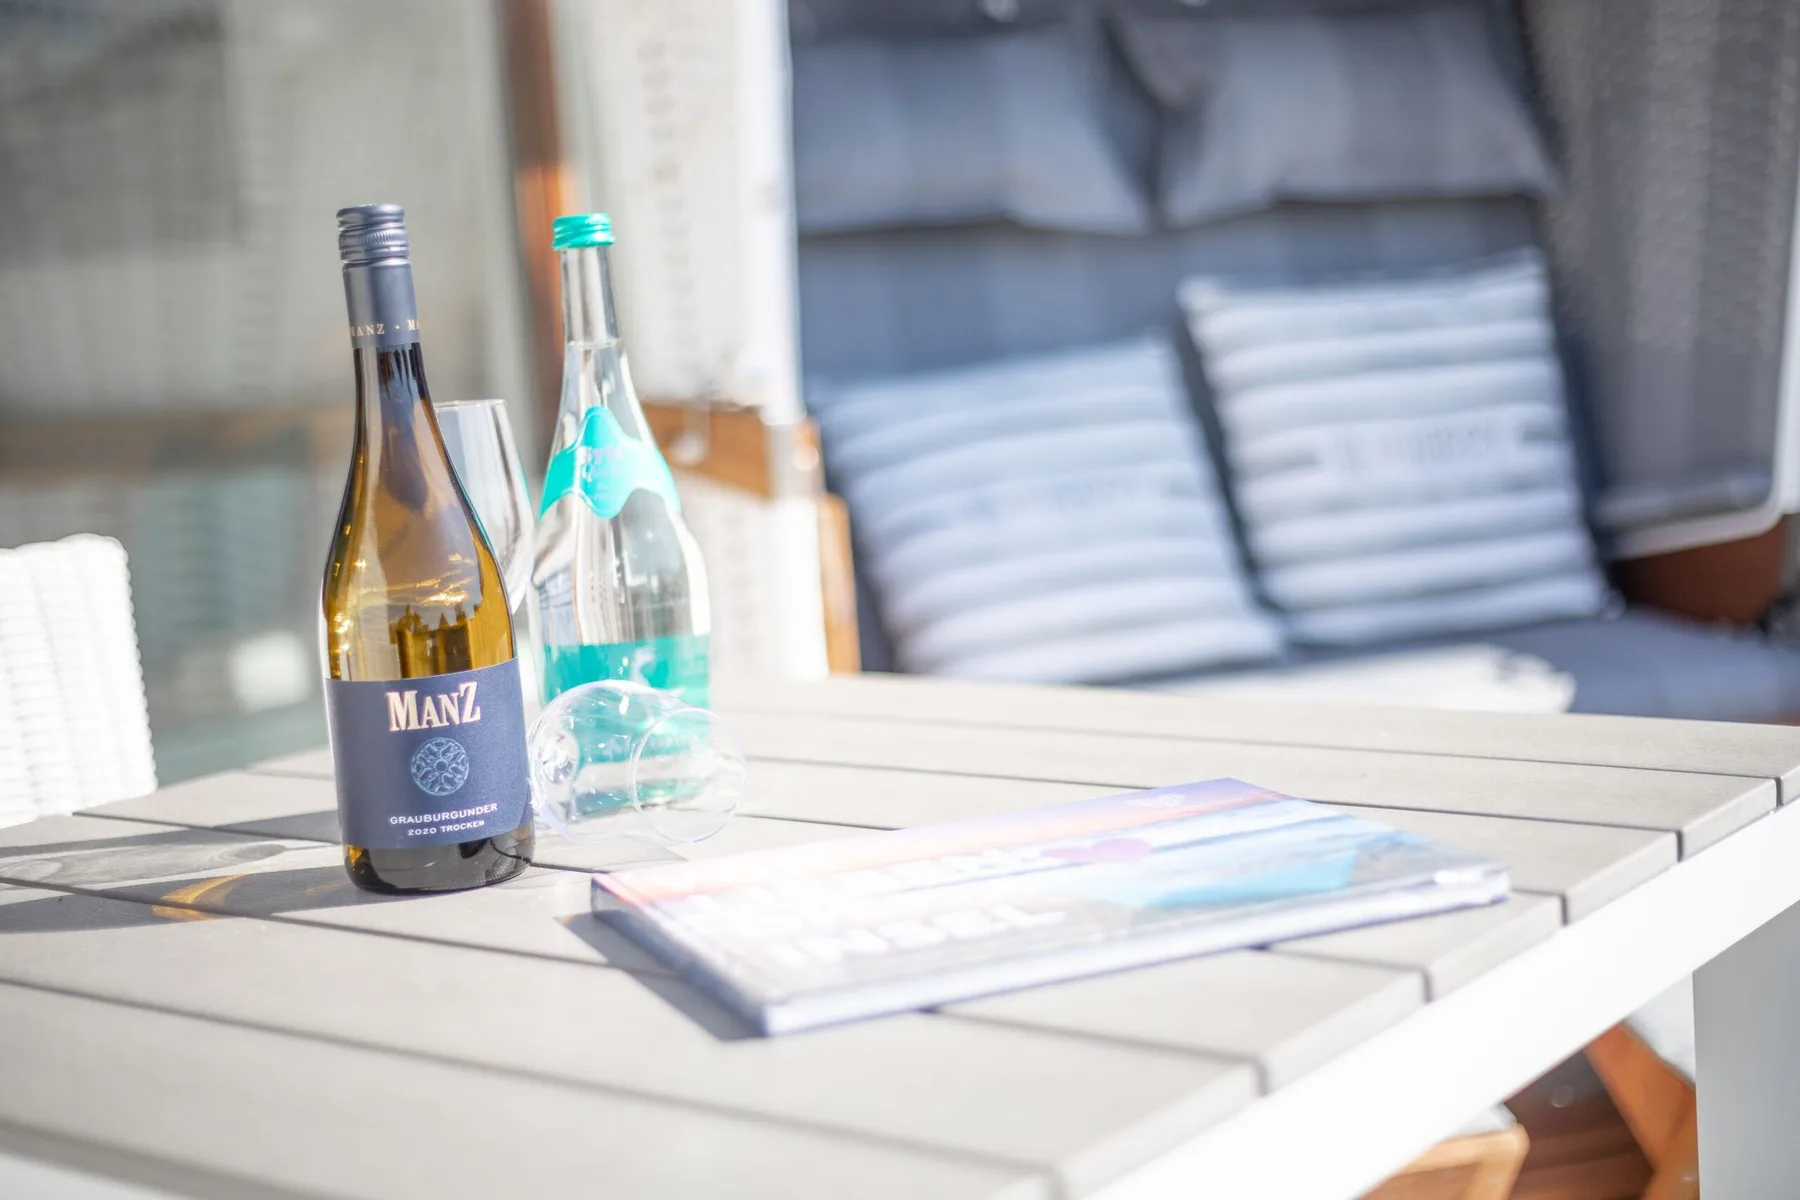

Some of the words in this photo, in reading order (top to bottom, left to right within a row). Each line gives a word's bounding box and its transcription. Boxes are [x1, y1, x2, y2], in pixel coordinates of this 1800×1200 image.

[390, 803, 498, 824] GRAUBURGUNDER
[407, 827, 437, 836] 2020
[440, 819, 485, 832] TROCKEN
